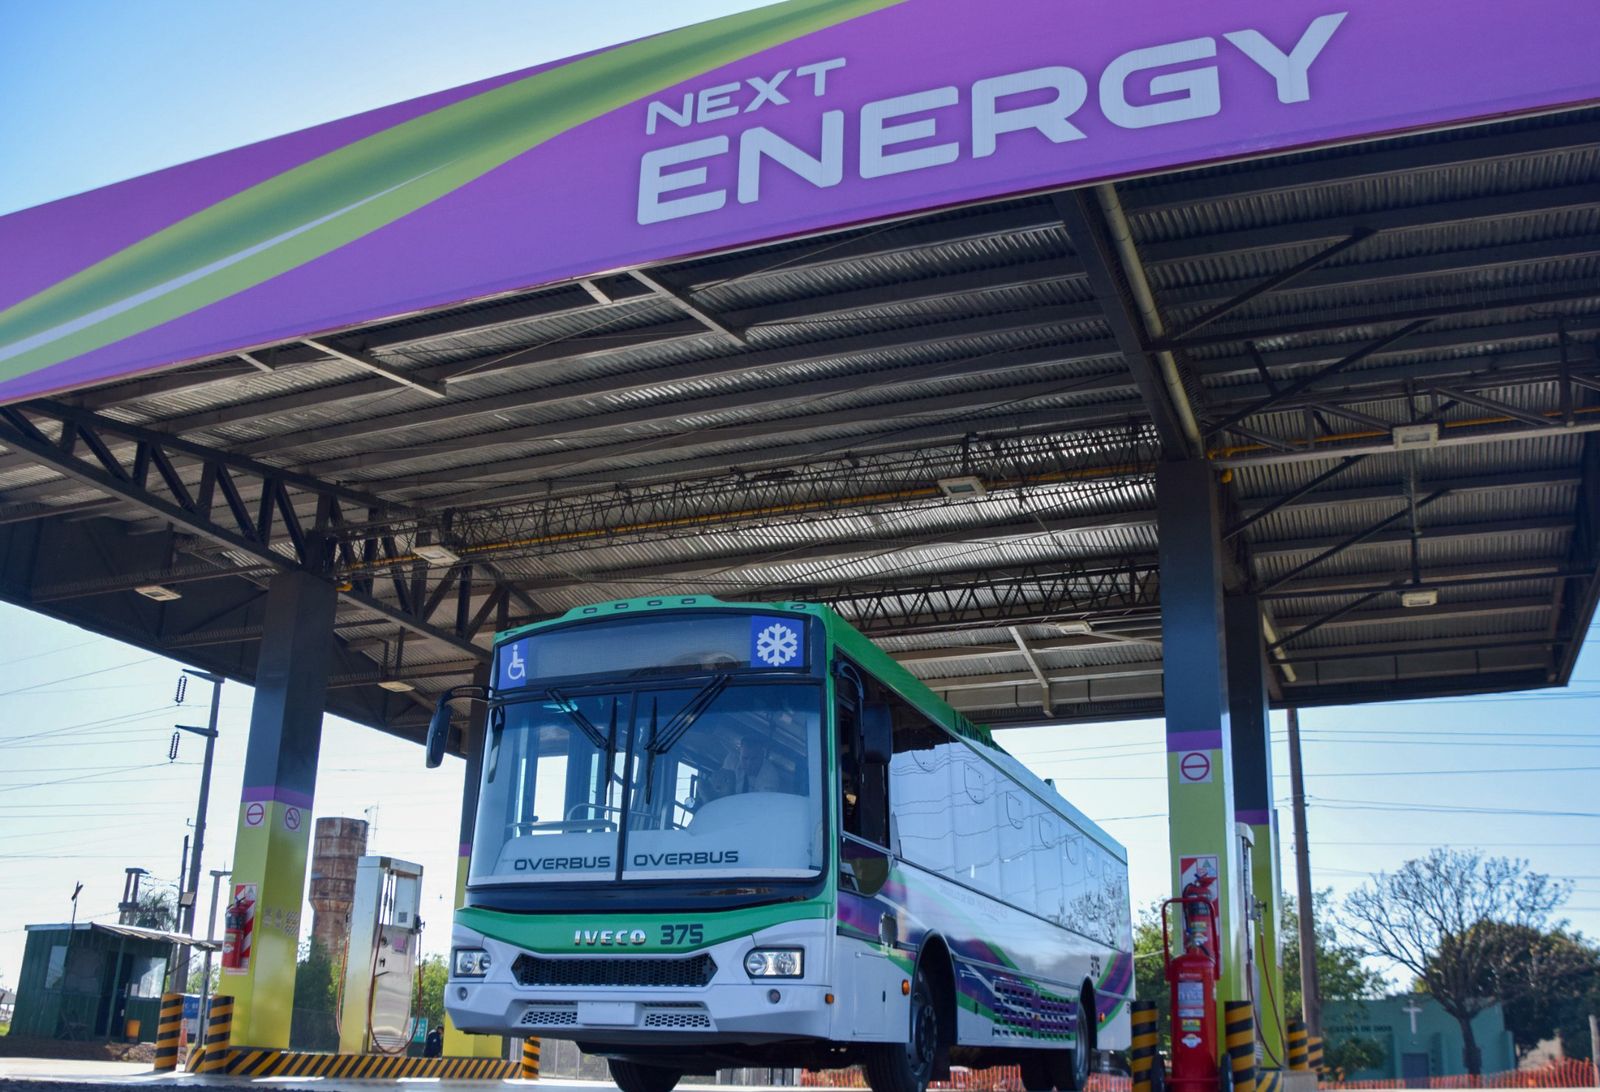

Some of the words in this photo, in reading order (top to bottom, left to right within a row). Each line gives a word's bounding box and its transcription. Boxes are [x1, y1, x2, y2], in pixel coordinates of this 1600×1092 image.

[646, 57, 846, 135] NEXT
[636, 11, 1348, 225] ENERGY
[514, 856, 611, 871] OVERBUS
[633, 851, 739, 867] OVERBUS
[574, 930, 646, 945] IVECO
[661, 924, 704, 945] 375
